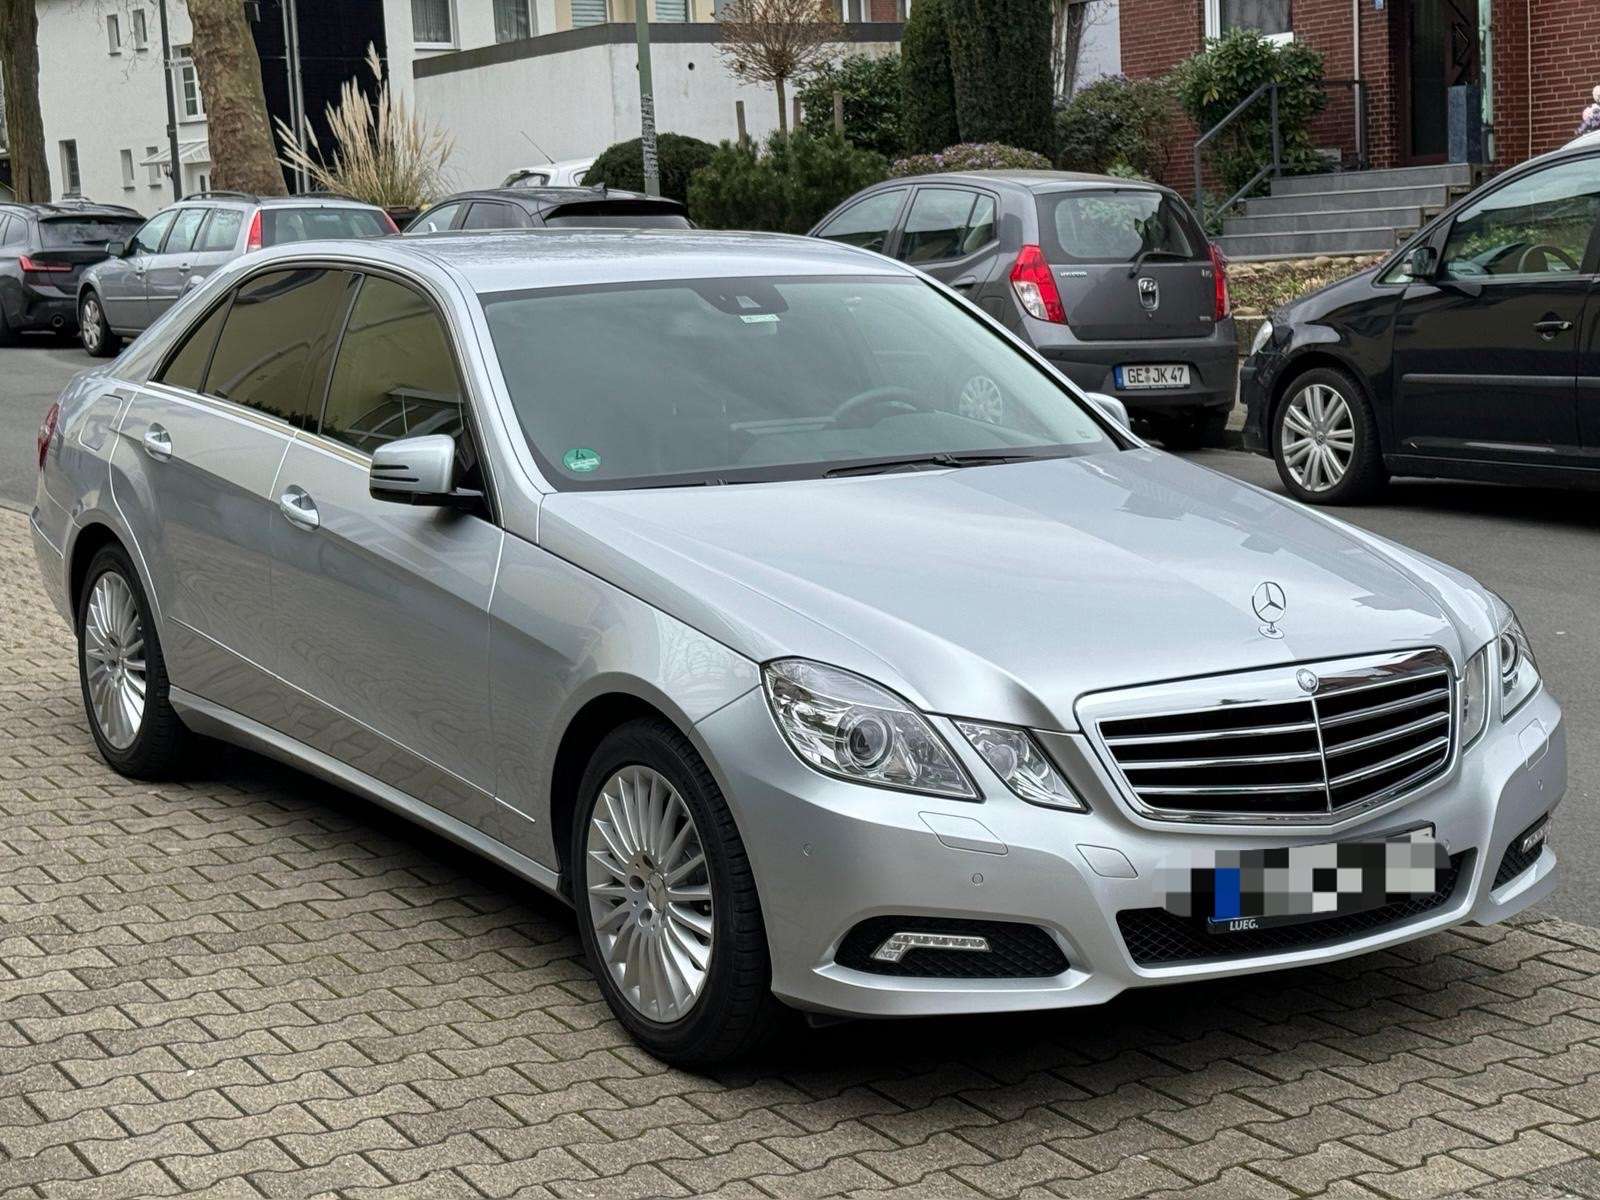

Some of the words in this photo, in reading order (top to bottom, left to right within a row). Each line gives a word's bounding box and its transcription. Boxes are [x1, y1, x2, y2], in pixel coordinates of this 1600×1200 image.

[1127, 367, 1144, 384] GE
[1152, 367, 1168, 383] JK
[1170, 367, 1184, 383] 47
[1229, 919, 1259, 931] LUEG.
